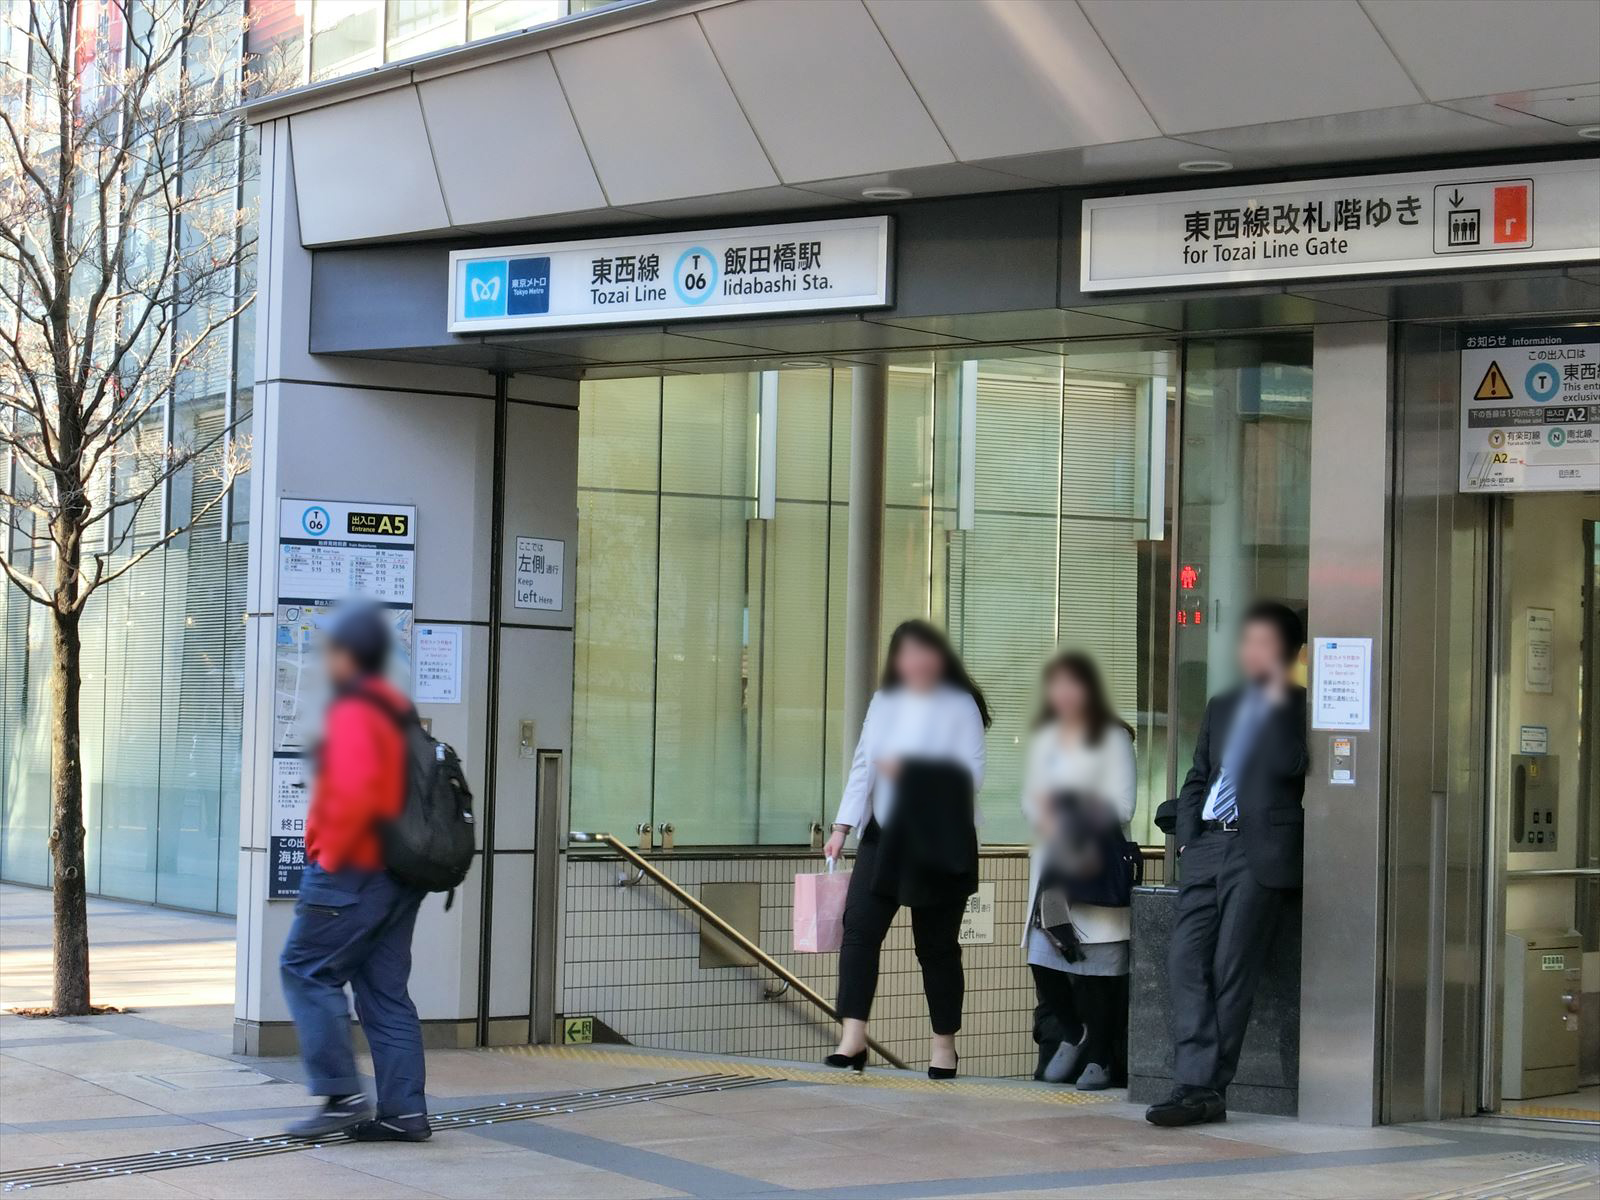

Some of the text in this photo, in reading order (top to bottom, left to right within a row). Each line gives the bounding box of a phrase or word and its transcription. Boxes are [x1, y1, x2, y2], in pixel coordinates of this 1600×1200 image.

[1183, 194, 1422, 242] 東西線改札階ゆき
[1183, 235, 1348, 264] for Tozai Line Gate
[692, 256, 700, 271] T
[723, 241, 821, 276] 飯田橋駅
[590, 253, 660, 286] 東西線
[512, 277, 547, 288] 東京メトロ
[684, 274, 707, 291] 06
[724, 272, 833, 297] Iidabashi Sta.
[590, 285, 667, 305] Tozai Line
[1466, 336, 1507, 348] お知らせ
[1512, 336, 1562, 346] Information
[1528, 349, 1586, 360] この出入口は
[1563, 362, 1600, 382] 東西
[1538, 376, 1547, 390] T
[1564, 382, 1581, 391] This
[1565, 408, 1586, 422] A2
[1494, 435, 1500, 444] Y
[1566, 430, 1592, 439] 南北線
[1493, 453, 1508, 464] A2
[314, 512, 319, 520] T
[351, 516, 376, 526] 出入口
[309, 520, 323, 530] 06
[378, 516, 406, 534] A5
[519, 542, 544, 552] ここでは
[518, 554, 559, 575] 左側通行
[518, 578, 534, 587] Keep
[518, 590, 553, 604] Left Here
[280, 838, 305, 848] この出
[278, 850, 304, 864] 海抜
[960, 928, 975, 940] Left
